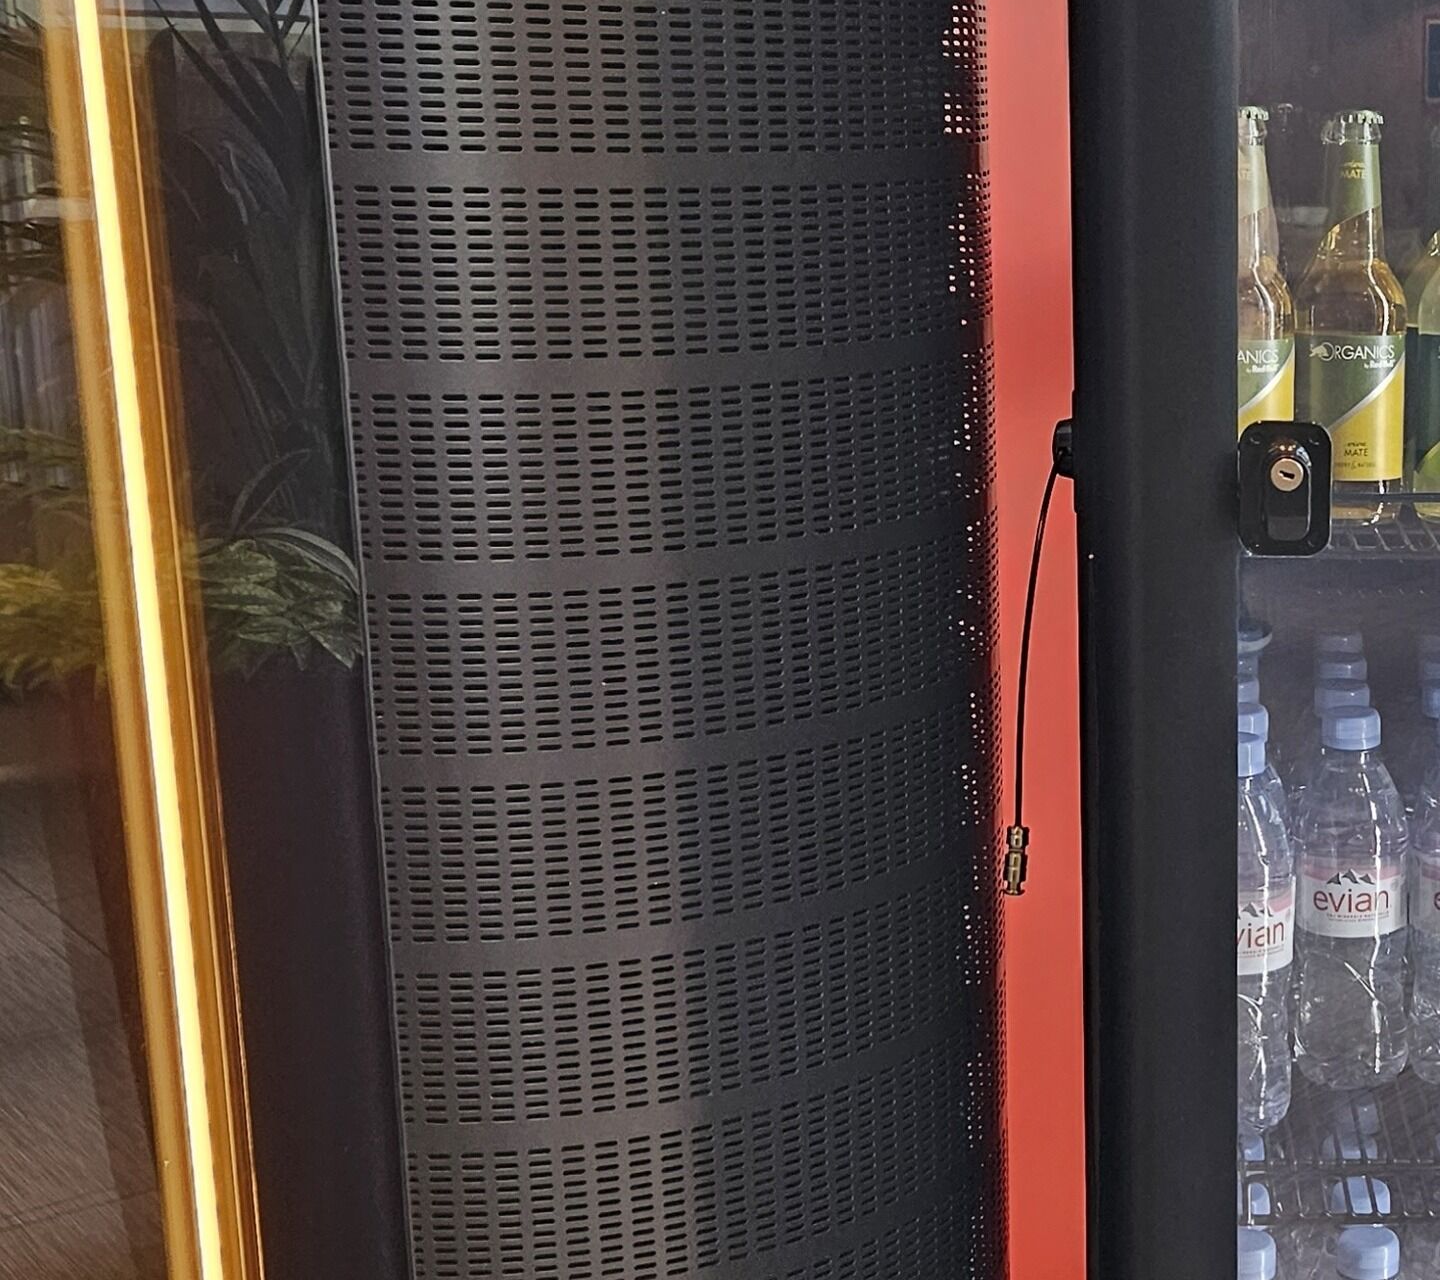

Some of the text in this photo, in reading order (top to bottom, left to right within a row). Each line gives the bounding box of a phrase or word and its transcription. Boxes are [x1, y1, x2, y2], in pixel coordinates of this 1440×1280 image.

[1237, 349, 1279, 364] ANICS
[1321, 341, 1395, 362] ORGANICS
[1343, 448, 1369, 458] MATE
[1313, 888, 1390, 914] evian
[1236, 921, 1285, 949] vian
